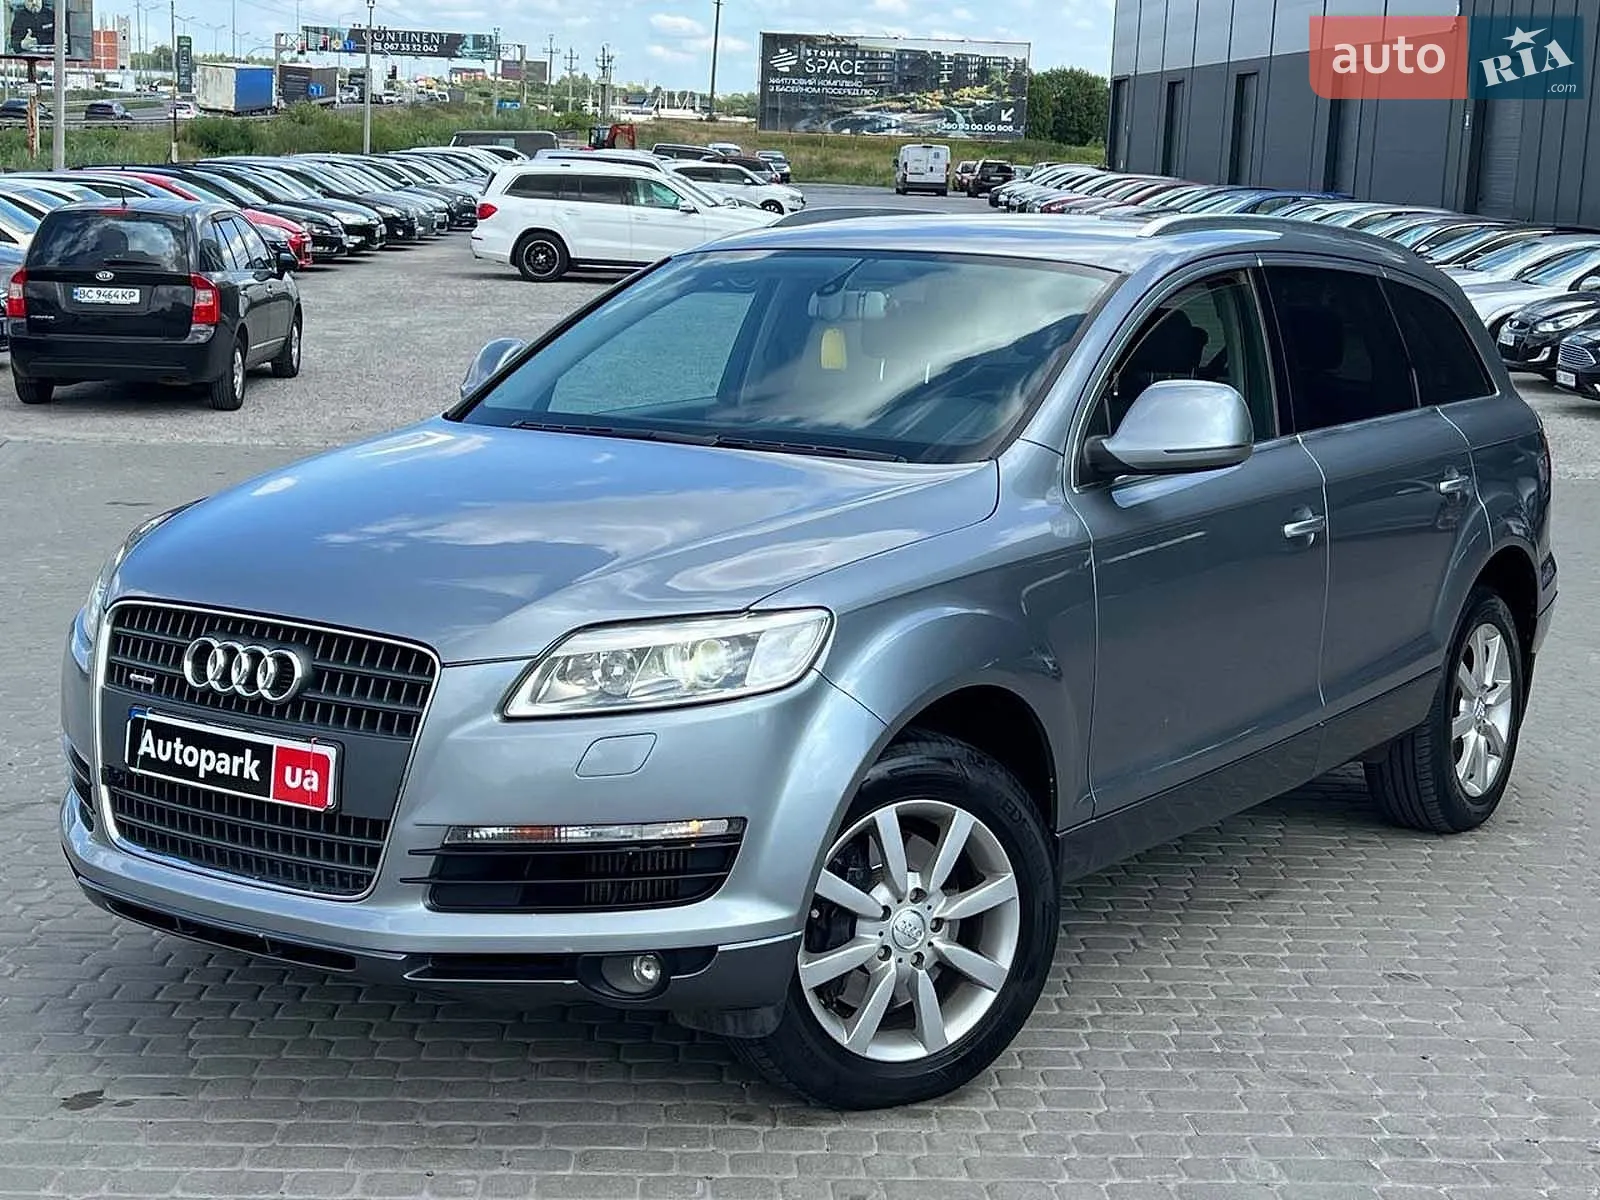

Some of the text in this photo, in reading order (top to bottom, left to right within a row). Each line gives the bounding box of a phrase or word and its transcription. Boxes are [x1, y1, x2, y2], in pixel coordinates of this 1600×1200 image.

[362, 31, 449, 44] CONTINENT
[384, 42, 399, 50] 067
[806, 49, 841, 57] STONE
[805, 58, 865, 75] SPACE
[80, 290, 94, 299] BC
[120, 291, 136, 300] KP
[137, 729, 320, 792] Autopark ua
